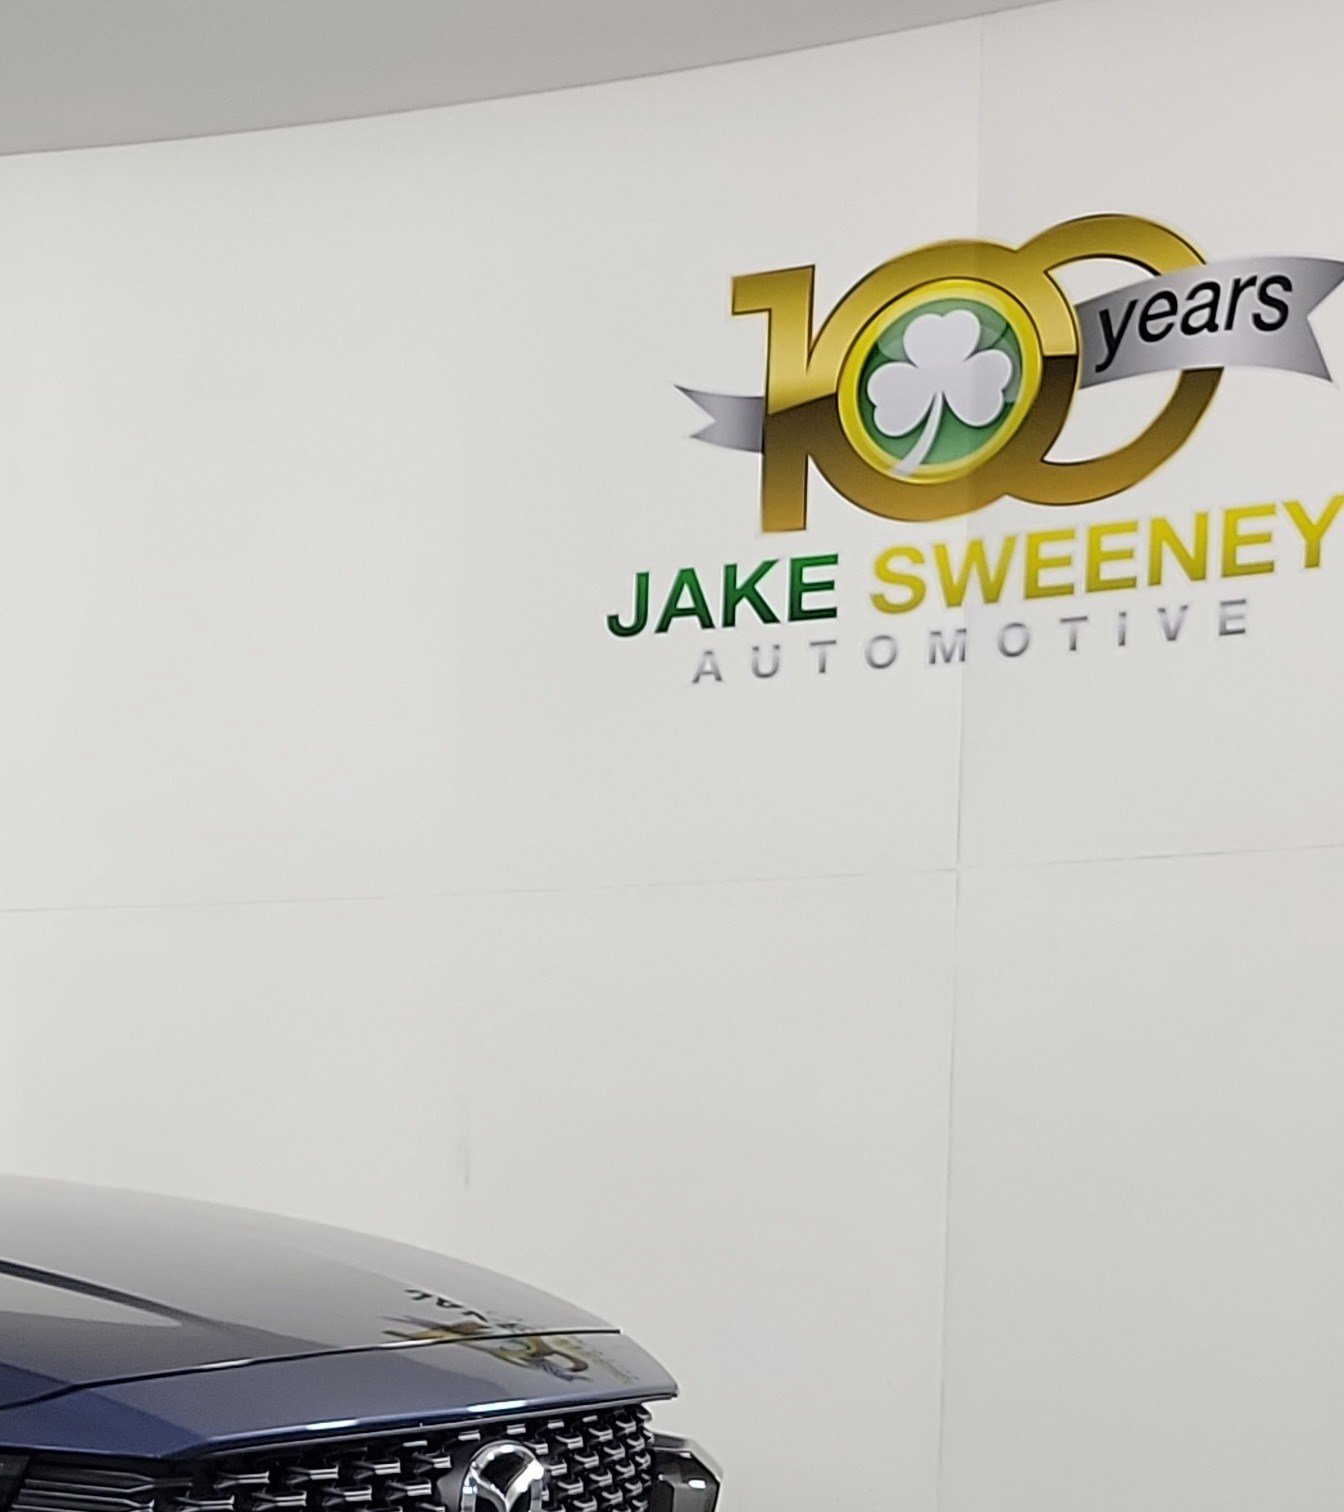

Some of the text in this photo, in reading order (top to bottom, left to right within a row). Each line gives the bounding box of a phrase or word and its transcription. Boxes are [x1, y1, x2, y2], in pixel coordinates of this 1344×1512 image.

[730, 213, 1293, 534] 100 years
[606, 492, 1344, 638] JAKE SWEENEY
[691, 600, 1249, 684] AUTOMOTIVE
